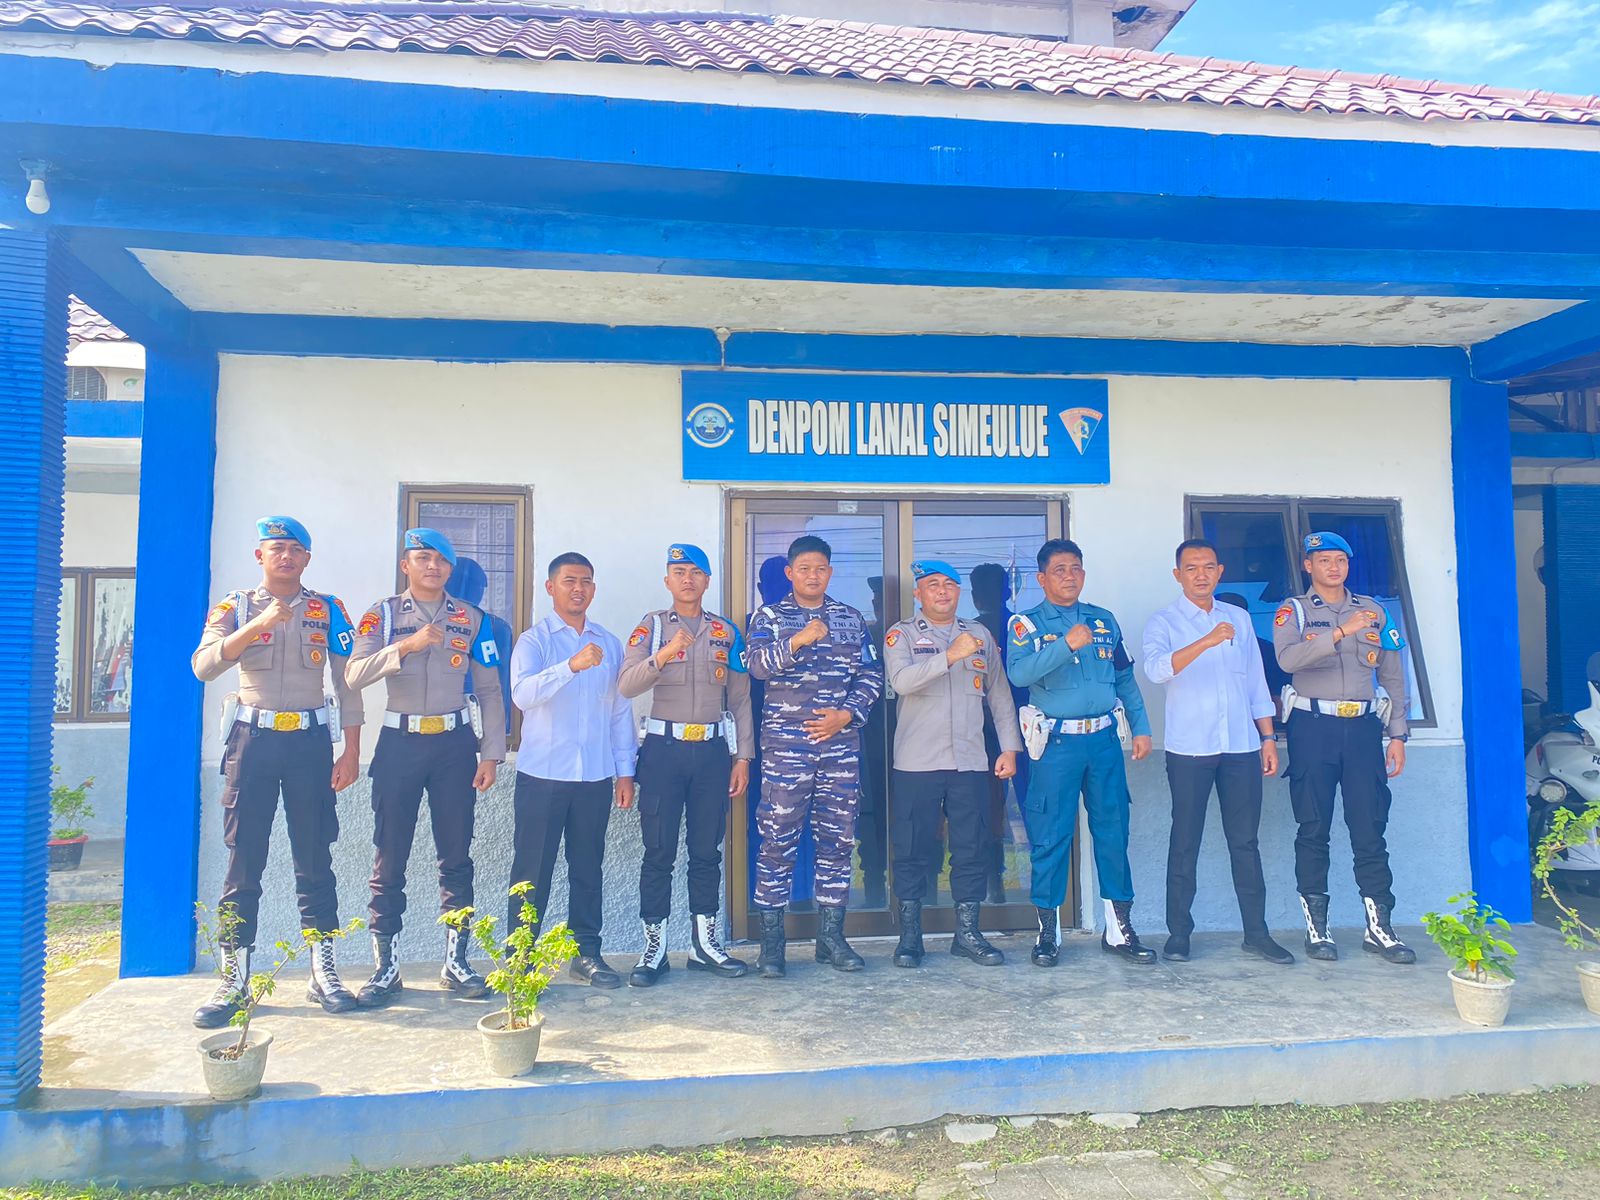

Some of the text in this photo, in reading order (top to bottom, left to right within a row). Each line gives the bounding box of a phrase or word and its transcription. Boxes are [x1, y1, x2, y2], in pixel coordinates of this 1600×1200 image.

[748, 399, 1050, 458] DENPOM LANAL SIMEULUE
